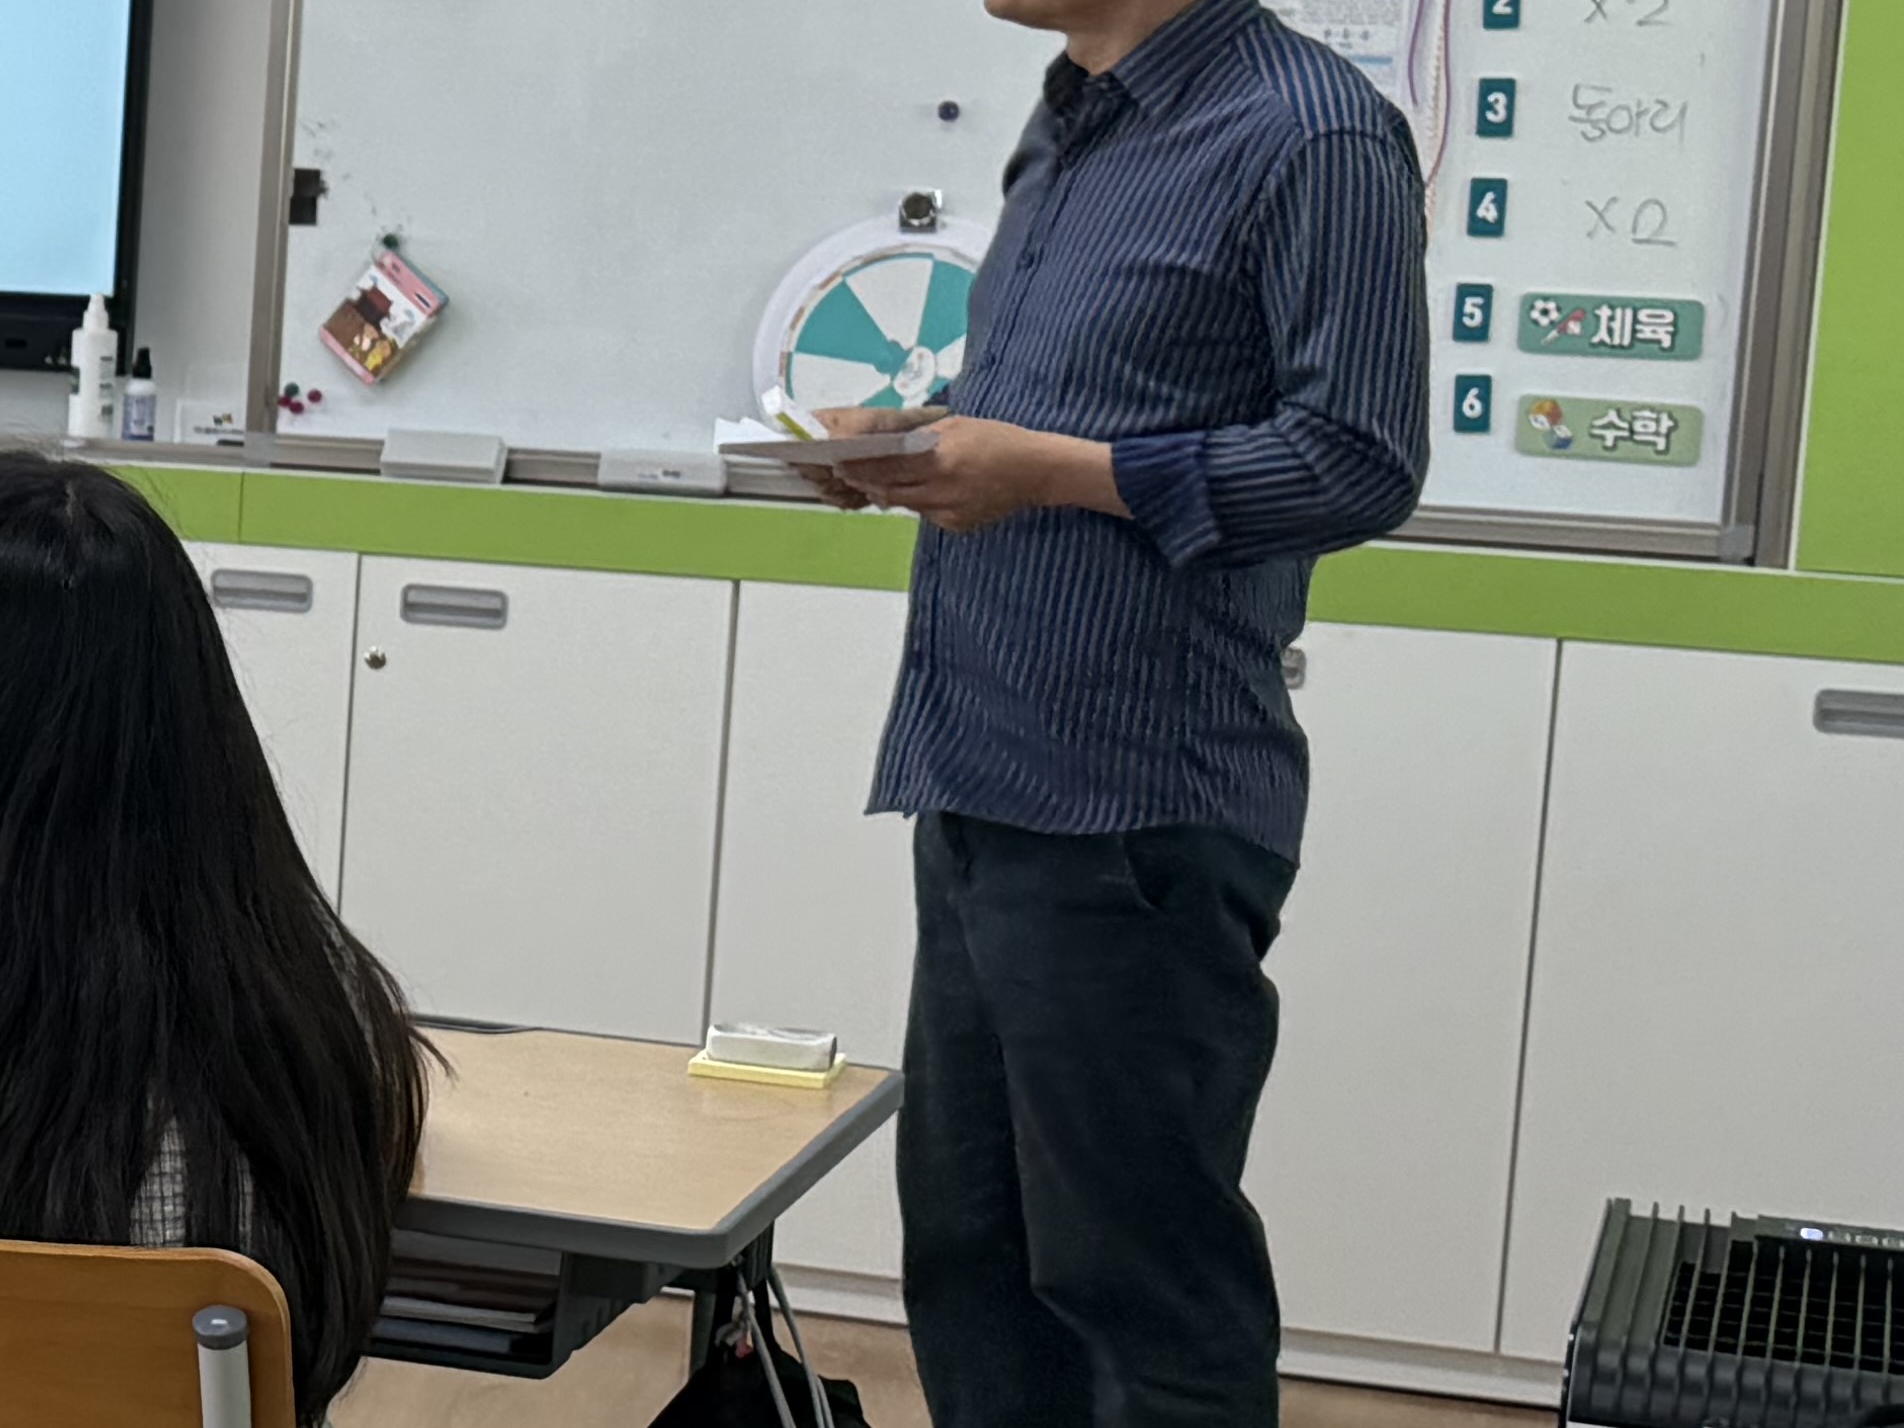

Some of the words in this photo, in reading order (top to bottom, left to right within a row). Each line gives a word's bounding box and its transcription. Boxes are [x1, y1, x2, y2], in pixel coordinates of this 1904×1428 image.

[1484, 92, 1508, 124] 3
[1568, 83, 1688, 153] 동아리
[1475, 191, 1498, 224] 4
[1462, 297, 1484, 328] 5
[1590, 304, 1677, 351] 체육
[1460, 388, 1482, 420] 6
[1589, 409, 1677, 454] 수학
